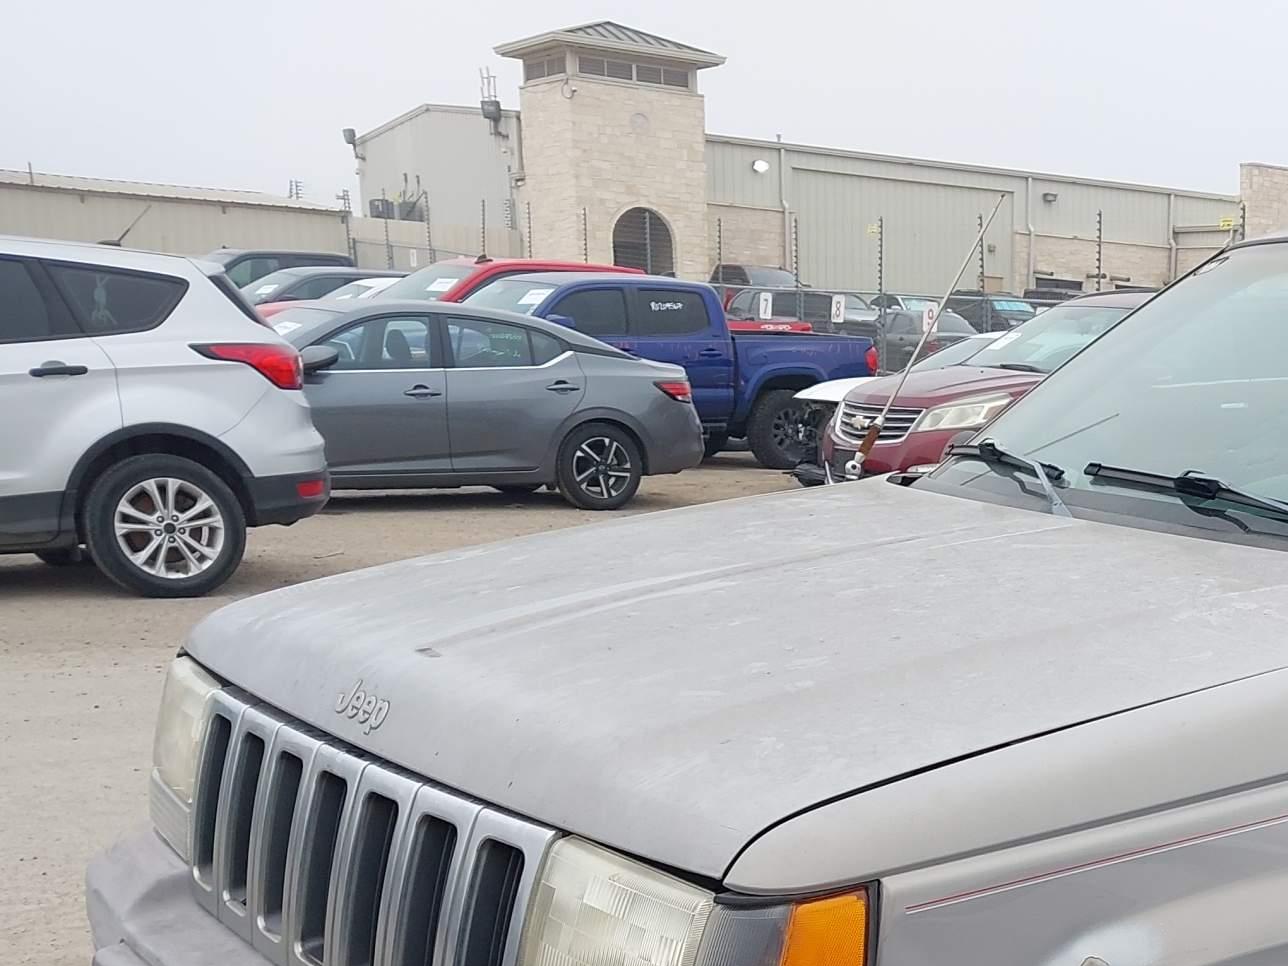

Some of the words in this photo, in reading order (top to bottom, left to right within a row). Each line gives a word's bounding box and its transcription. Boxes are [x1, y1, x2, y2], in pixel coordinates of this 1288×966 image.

[763, 298, 769, 314] 7
[835, 301, 841, 317] 8
[335, 679, 391, 736] Jeep
